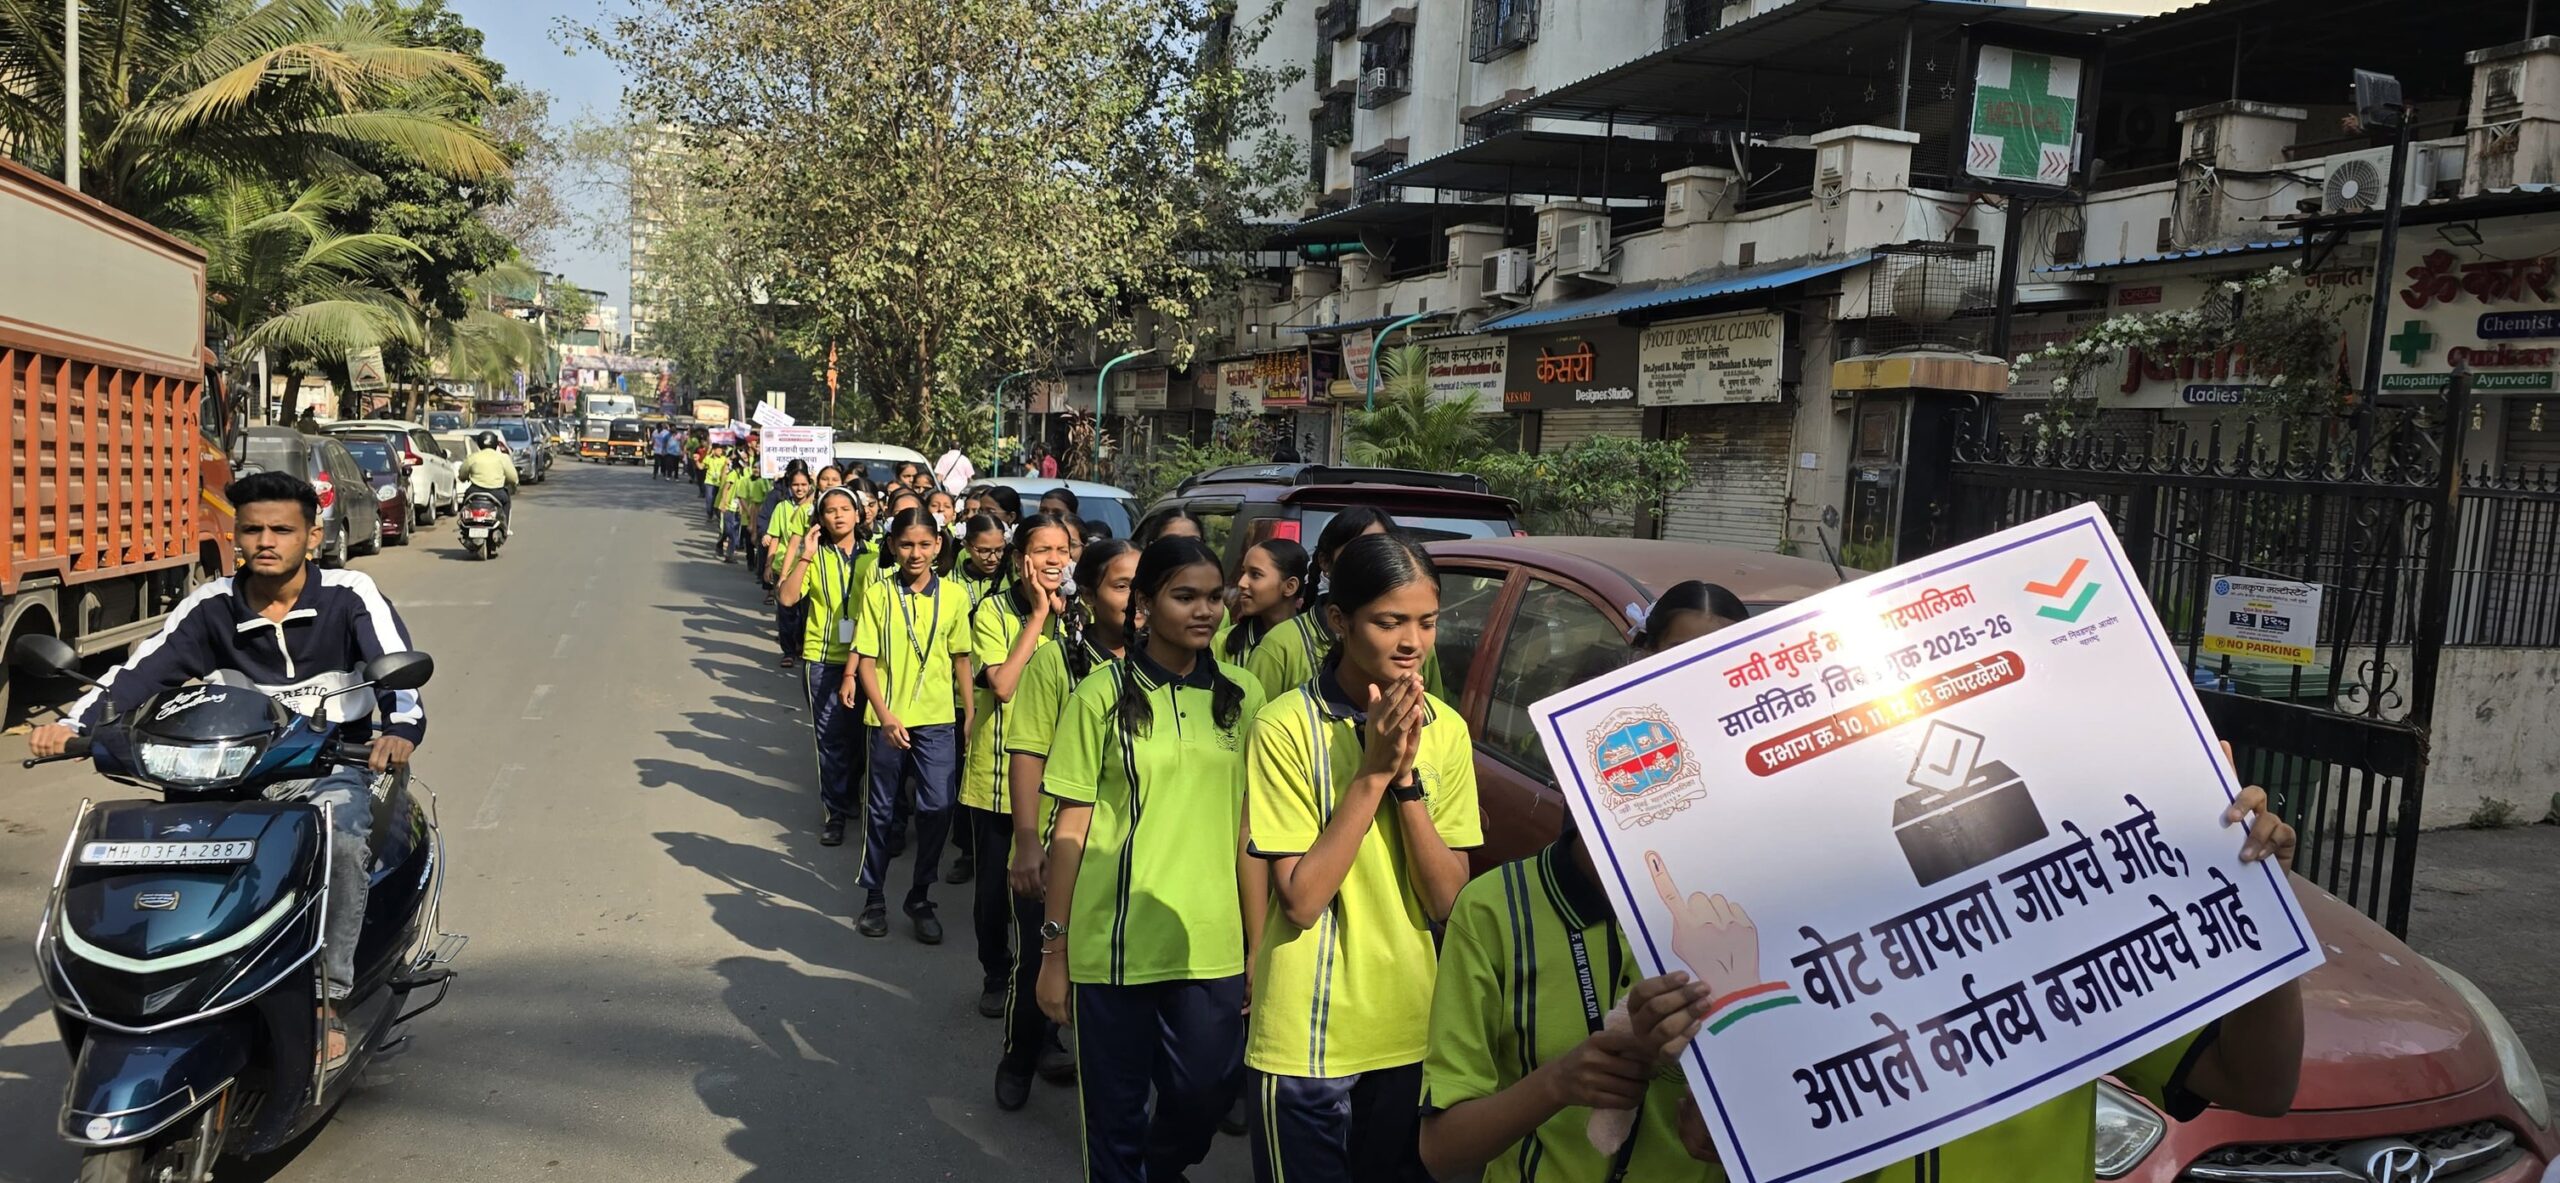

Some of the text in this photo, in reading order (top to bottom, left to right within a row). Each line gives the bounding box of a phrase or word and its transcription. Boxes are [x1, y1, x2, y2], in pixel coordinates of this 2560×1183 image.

[1643, 319, 1774, 351] JYOTI DENTAL CLINIC
[2483, 314, 2553, 332] Chemist
[1536, 341, 1596, 384] केसरी
[2386, 373, 2547, 389] Allopathic Ayurvedic
[1505, 391, 1533, 405] KESARI
[2188, 387, 2238, 403] Ladies
[1723, 652, 1771, 689] नवी
[1769, 631, 1823, 679] मुंबई
[2227, 639, 2301, 657] NO PARKING
[1718, 683, 1817, 738] सार्वत्रिक
[1924, 614, 2012, 662] 2025-26
[1760, 735, 1814, 770] प्रभाग
[1815, 724, 1842, 751] क्र.
[1841, 714, 1869, 738] 10,
[1915, 689, 1934, 709] 13
[1934, 656, 2014, 702] कोपरखैरणे
[1791, 793, 2188, 1010] वोट द्यायला जायचे आहे,
[1573, 942, 1587, 967] NAIK
[1579, 967, 1600, 1020] VIDYALAYA
[1793, 867, 2261, 1129] आपले कर्तव्य बजावायचे आहे
